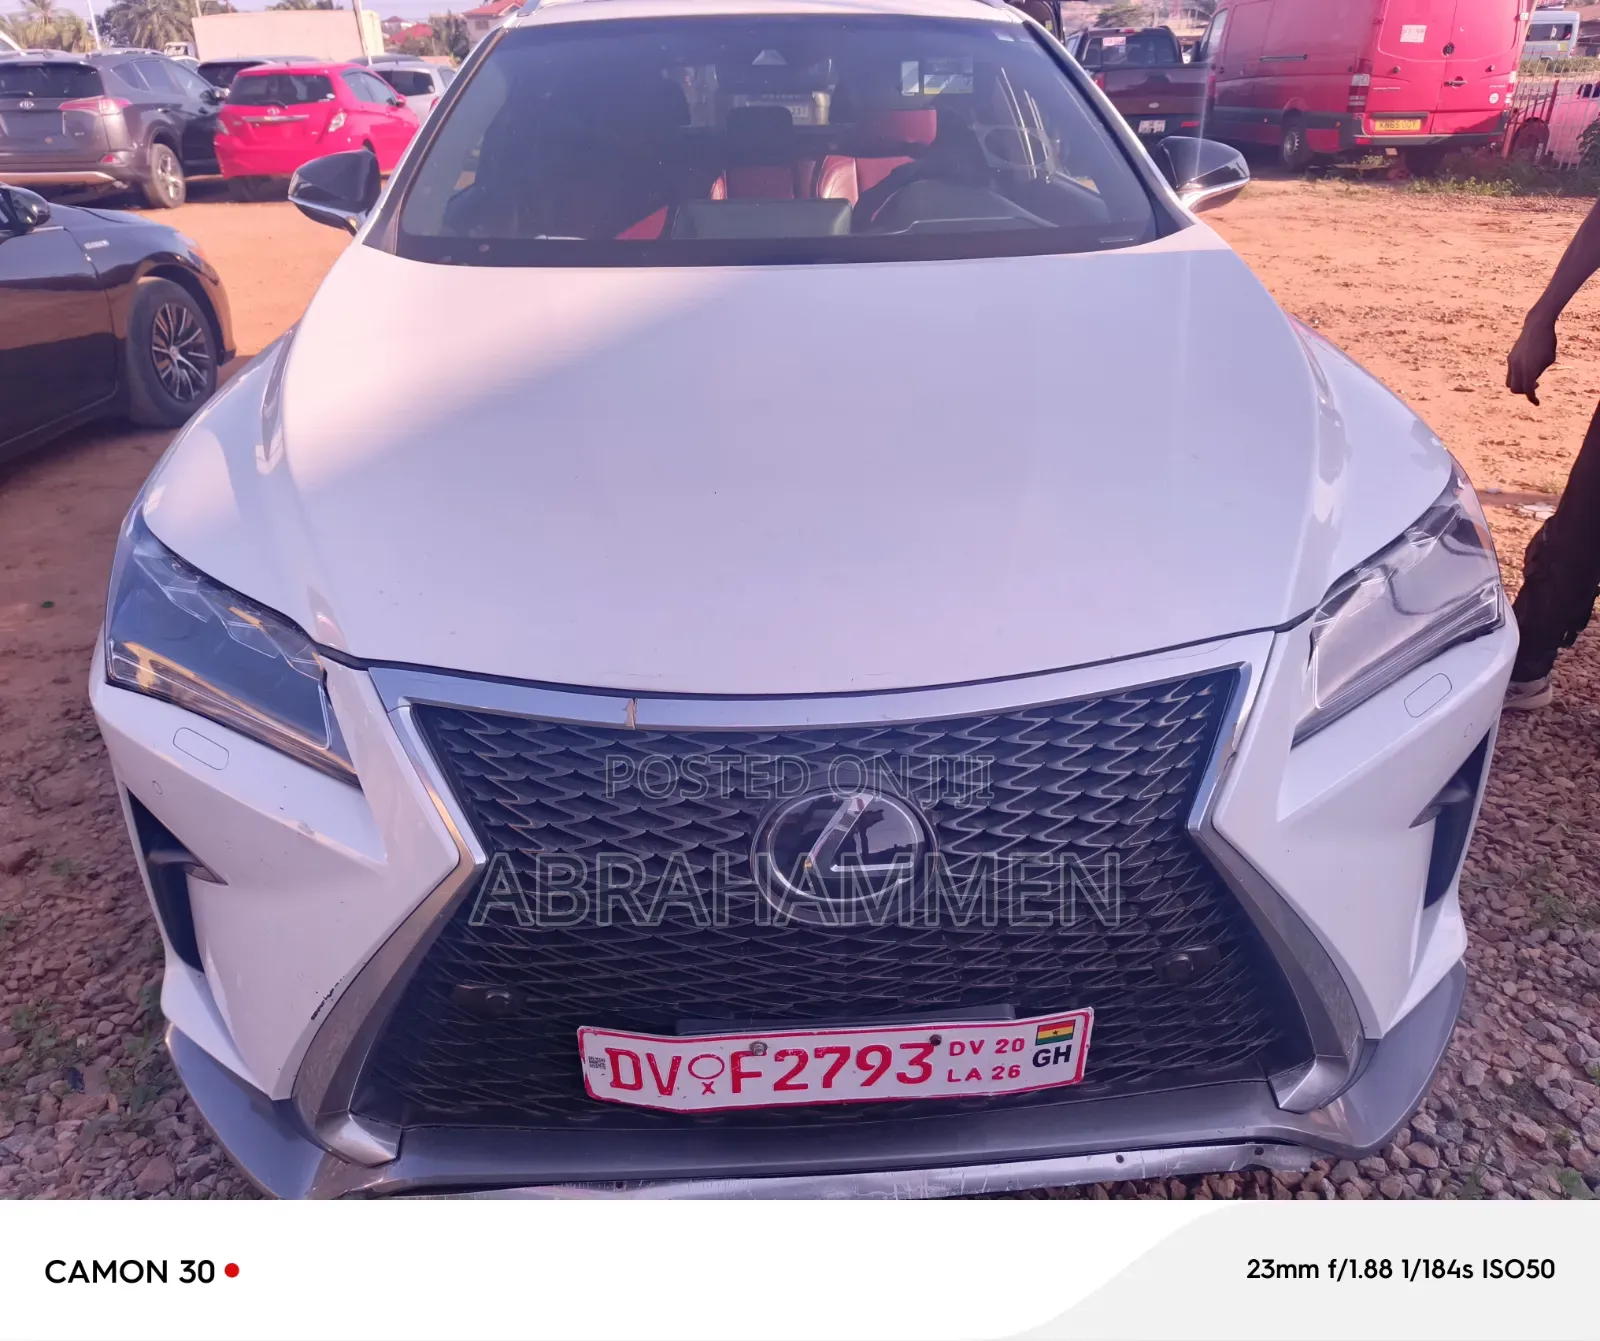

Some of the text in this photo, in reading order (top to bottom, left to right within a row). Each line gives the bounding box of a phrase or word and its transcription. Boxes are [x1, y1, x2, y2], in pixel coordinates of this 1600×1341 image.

[948, 1037, 1026, 1057] DV 20
[1031, 1044, 1073, 1068] GH
[604, 1046, 682, 1097] DV
[730, 1042, 936, 1094] F2793
[947, 1064, 1022, 1083] LA 26
